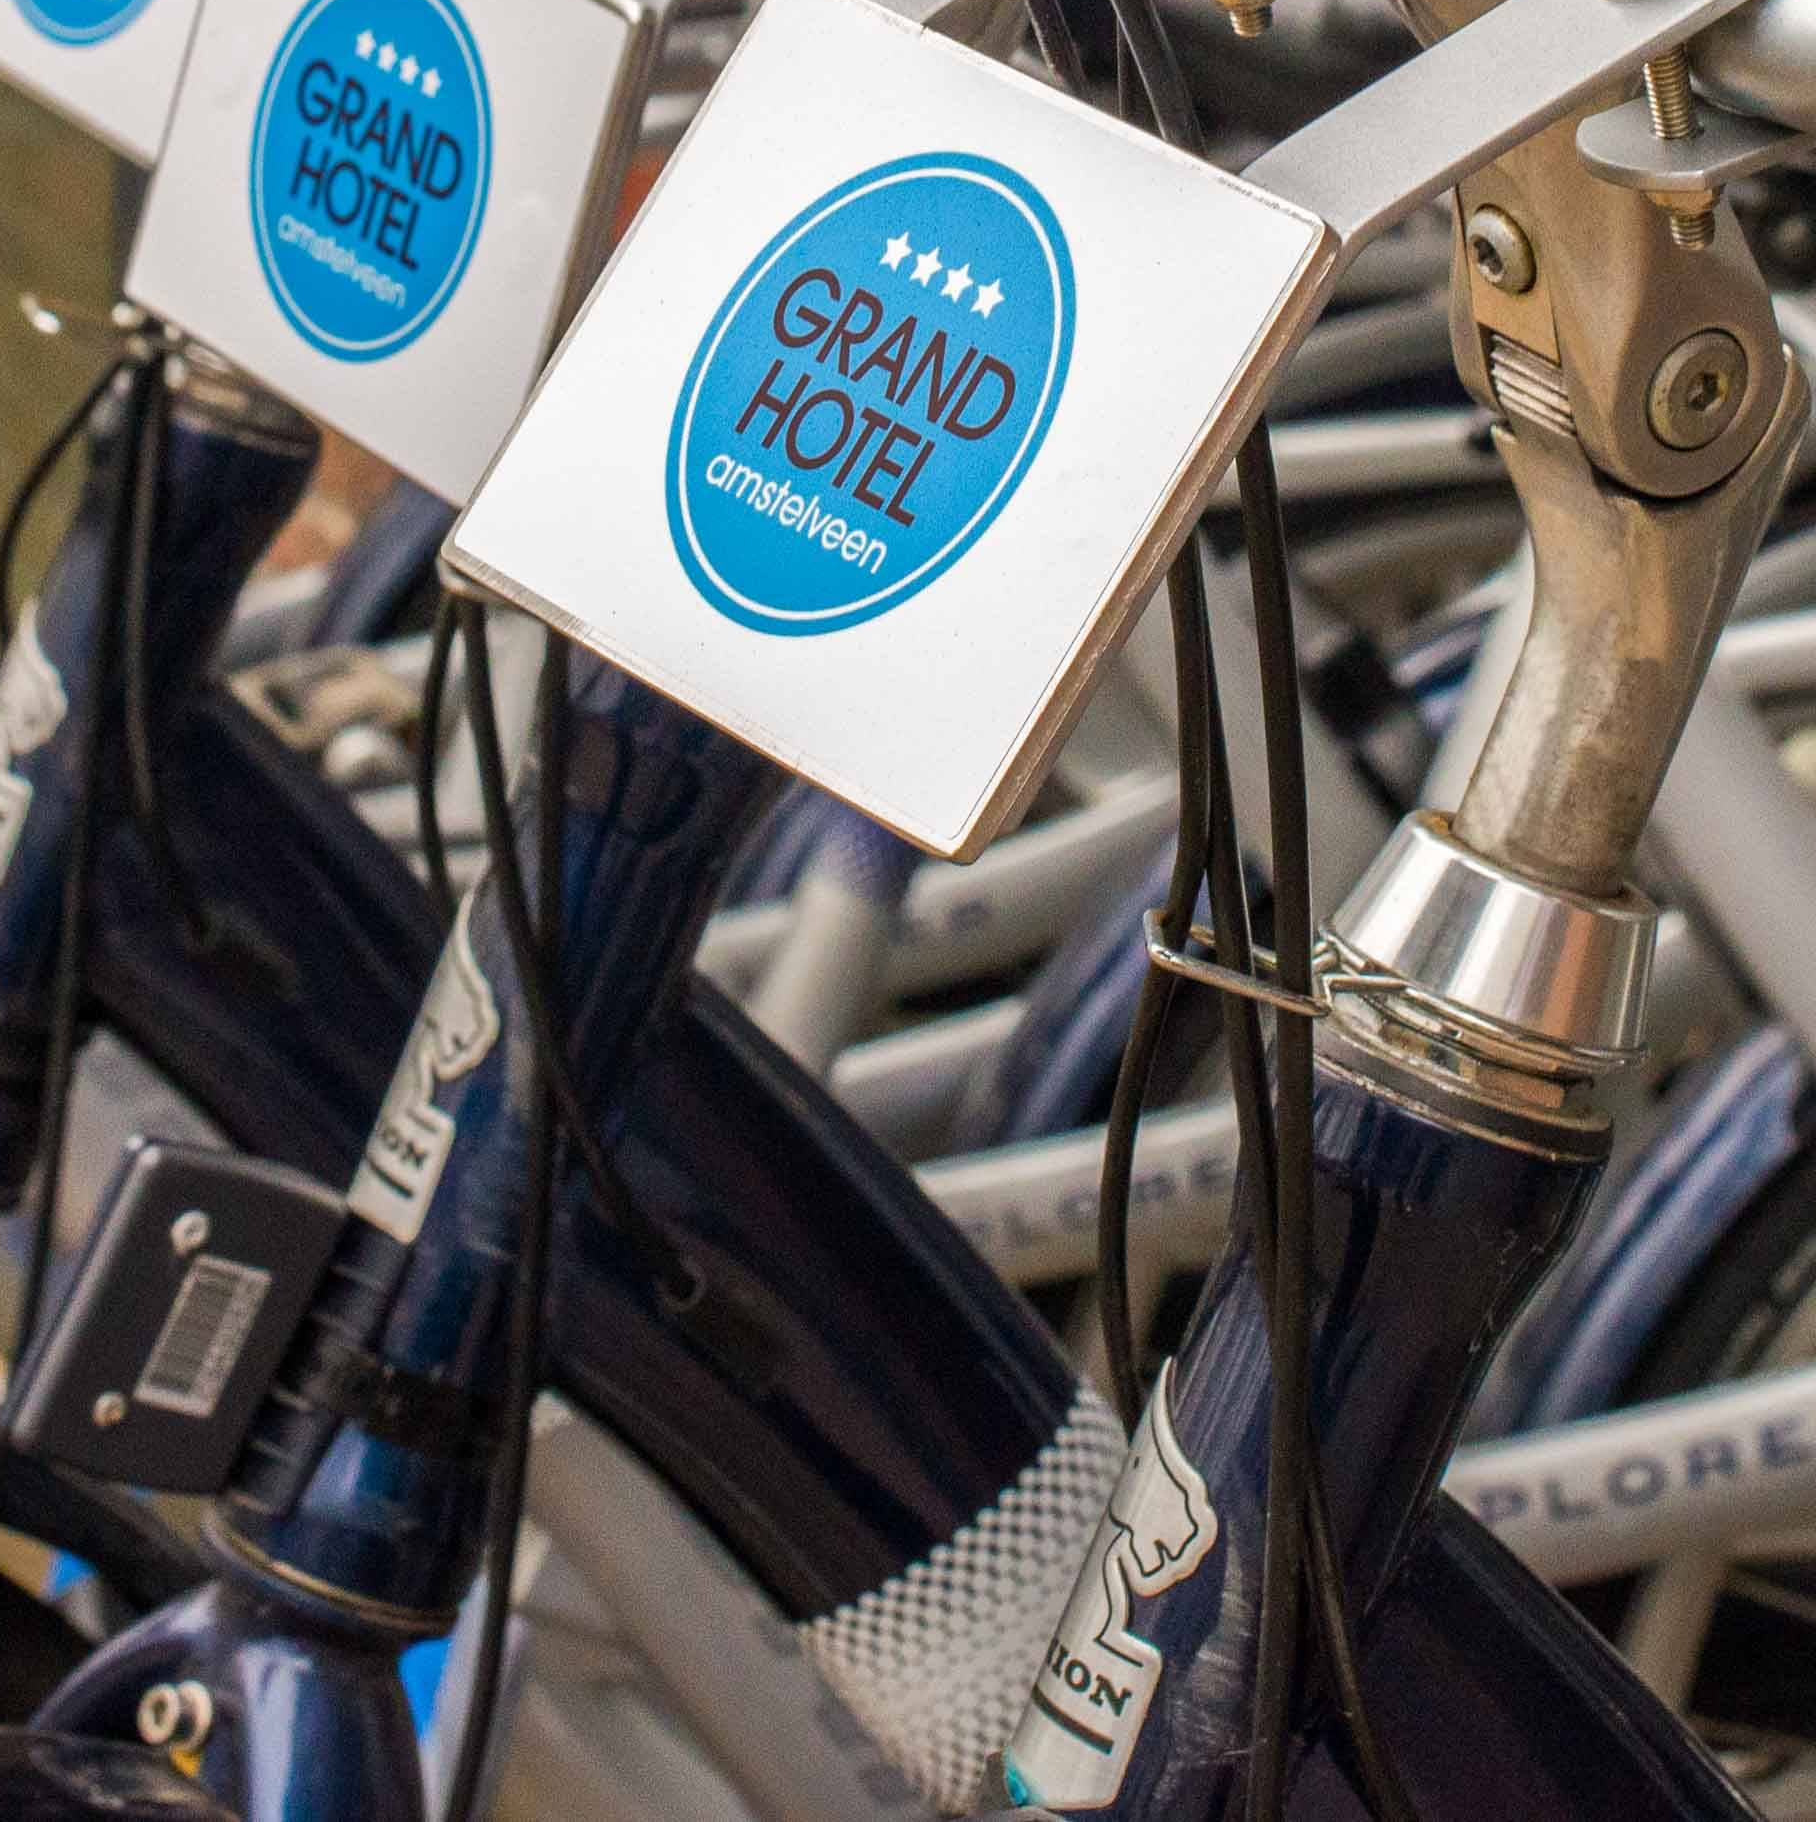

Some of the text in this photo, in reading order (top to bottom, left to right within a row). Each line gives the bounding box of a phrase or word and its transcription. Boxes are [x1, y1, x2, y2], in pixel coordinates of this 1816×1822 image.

[296, 59, 464, 200] GRAND
[289, 136, 420, 272] HOTEL
[772, 268, 1016, 441] GRAND
[734, 360, 938, 527] HOTEL
[706, 453, 888, 575] amstelveen
[1047, 1638, 1133, 1718] ION
